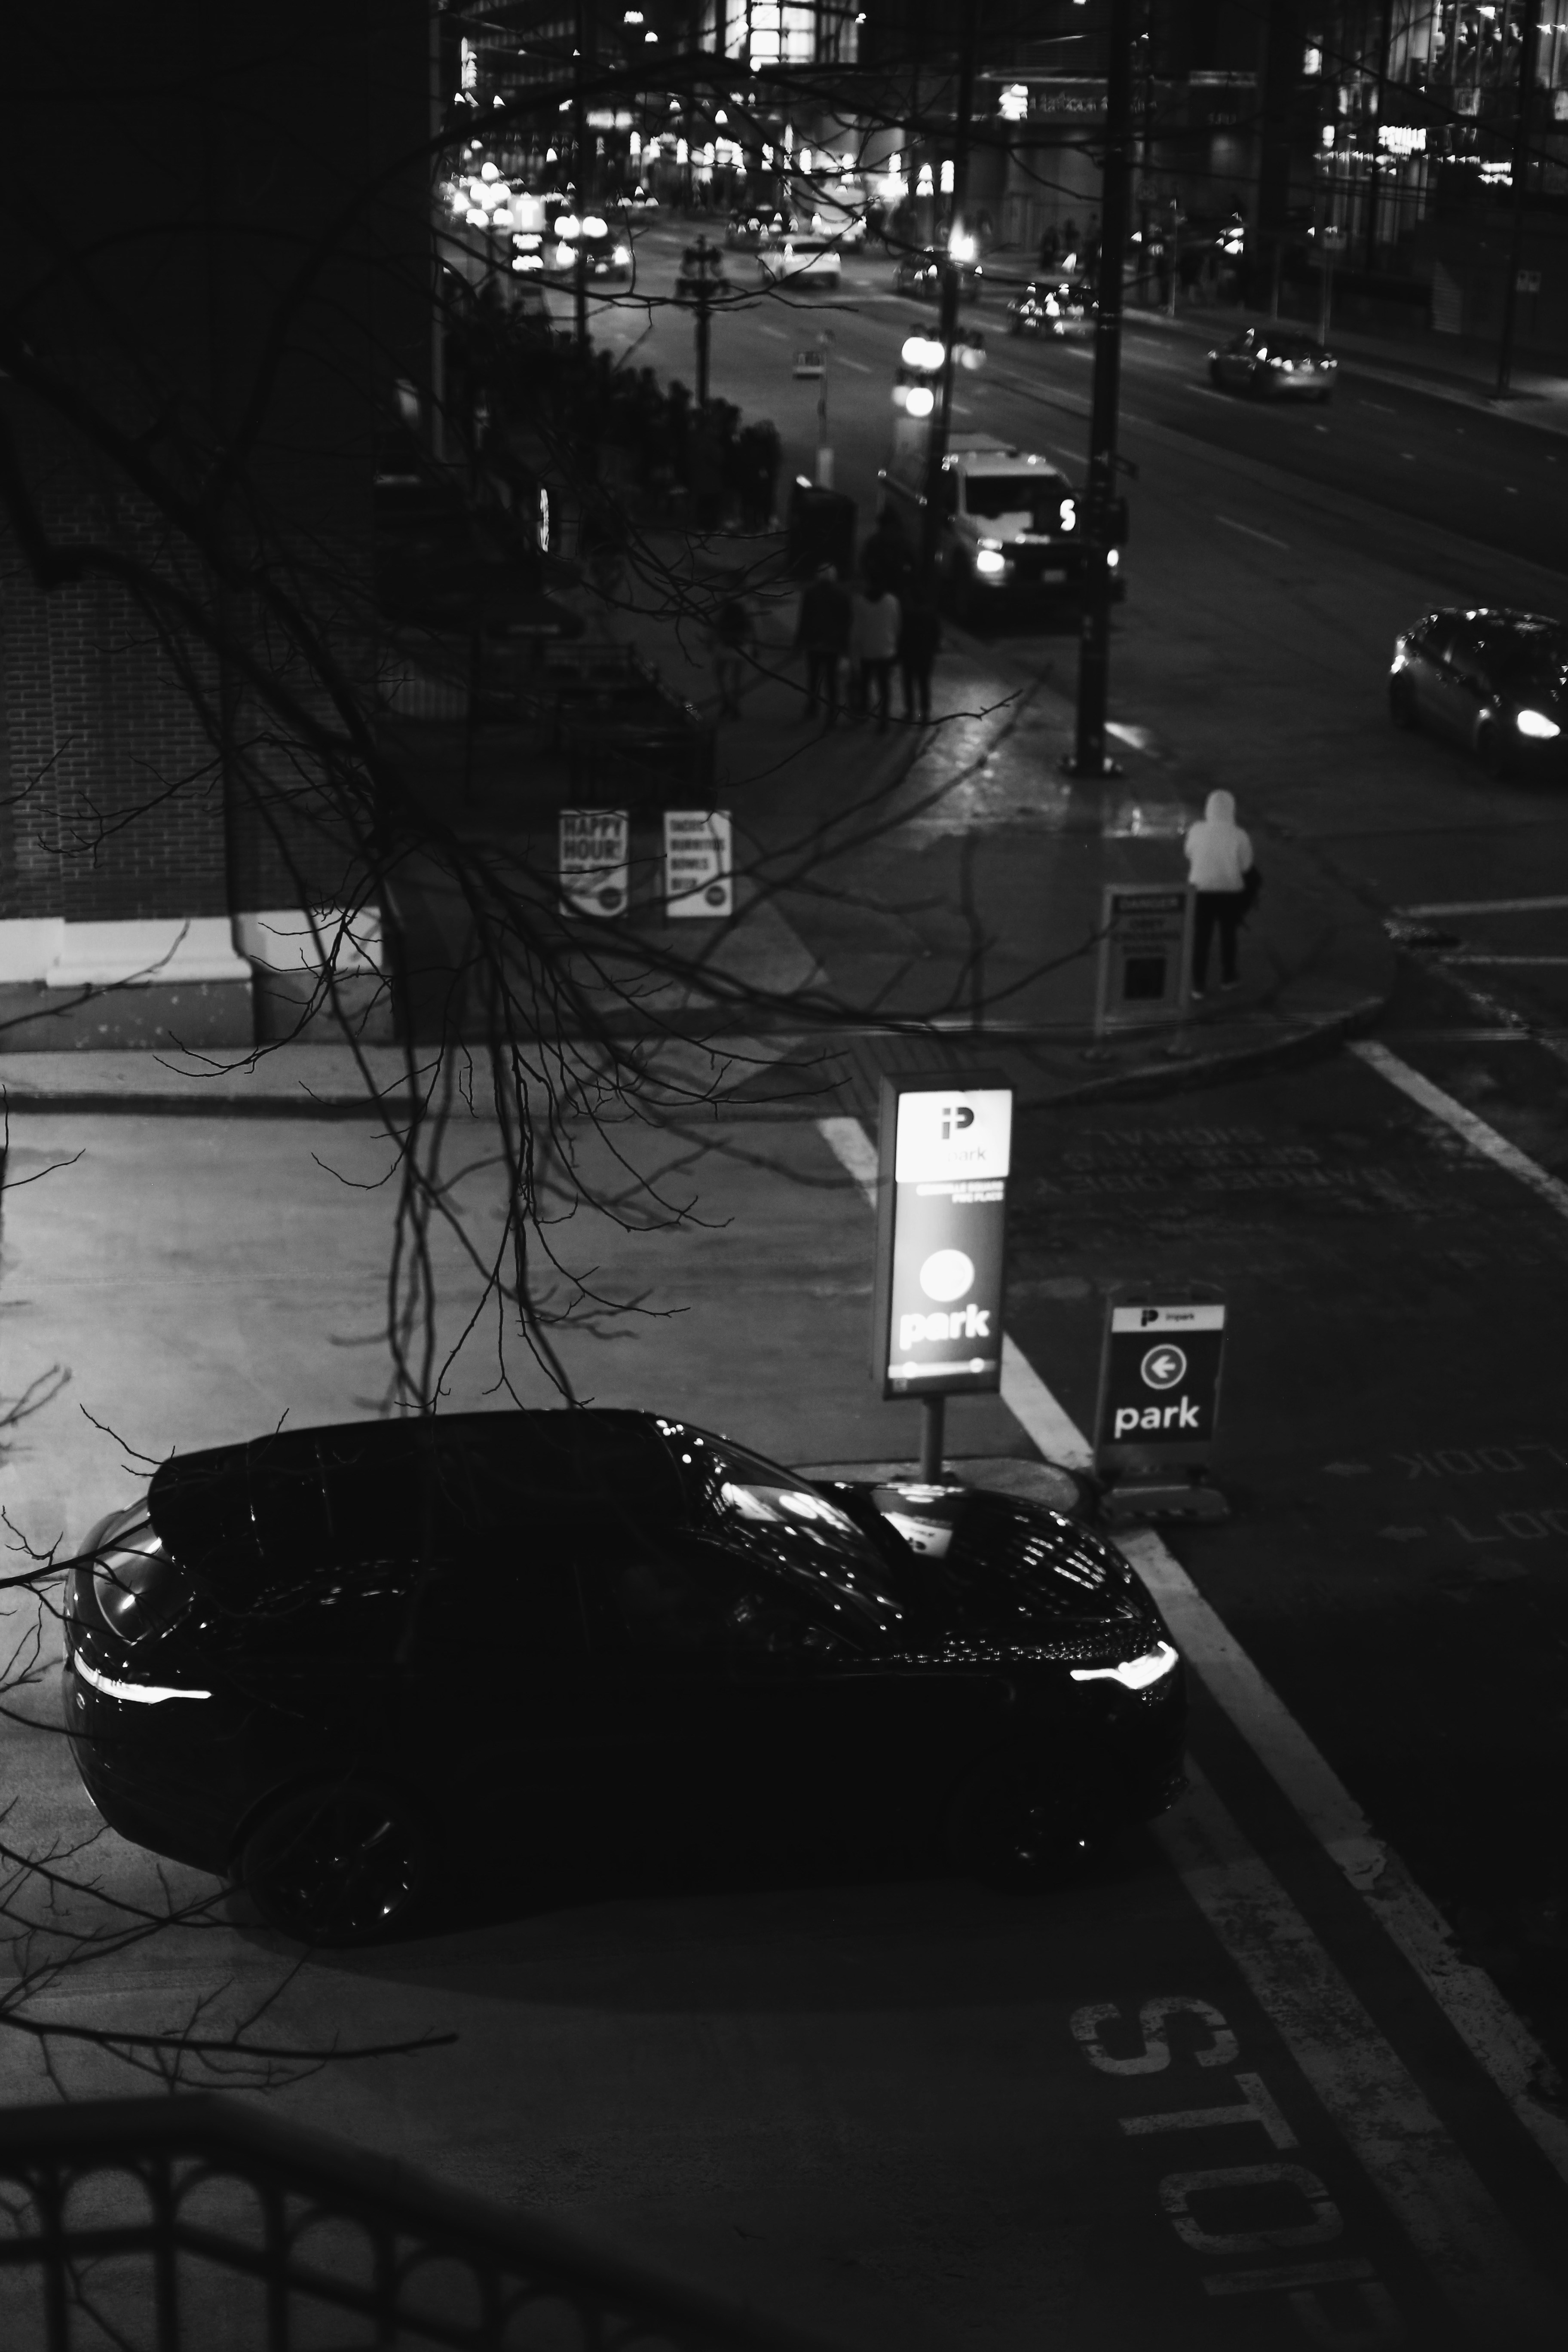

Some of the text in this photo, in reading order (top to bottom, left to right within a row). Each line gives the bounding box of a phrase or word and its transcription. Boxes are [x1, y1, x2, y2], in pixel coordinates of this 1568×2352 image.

[564, 818, 621, 836] HAPPY
[899, 1304, 990, 1350] park
[1114, 1396, 1200, 1439] park
[1069, 1996, 1409, 2349] STOP
